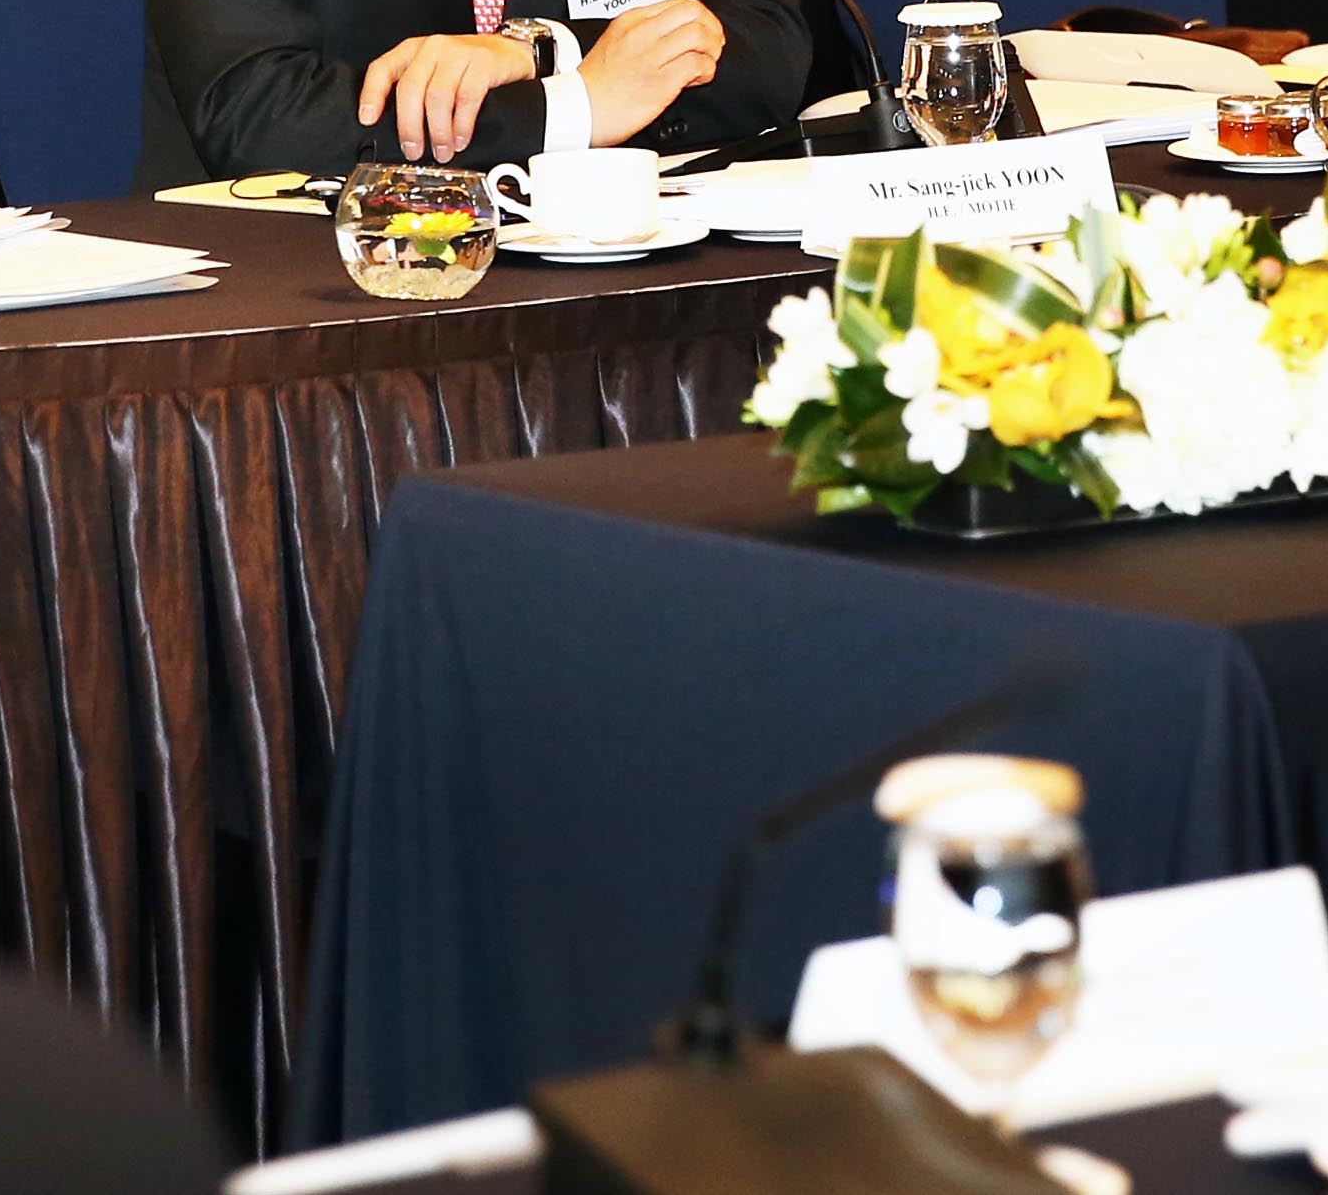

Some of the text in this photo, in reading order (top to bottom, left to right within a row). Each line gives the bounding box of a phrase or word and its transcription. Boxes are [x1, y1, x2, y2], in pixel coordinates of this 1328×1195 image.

[868, 165, 1065, 200] Mr. Sang-jick YOON
[967, 198, 1019, 214] MOTIE
